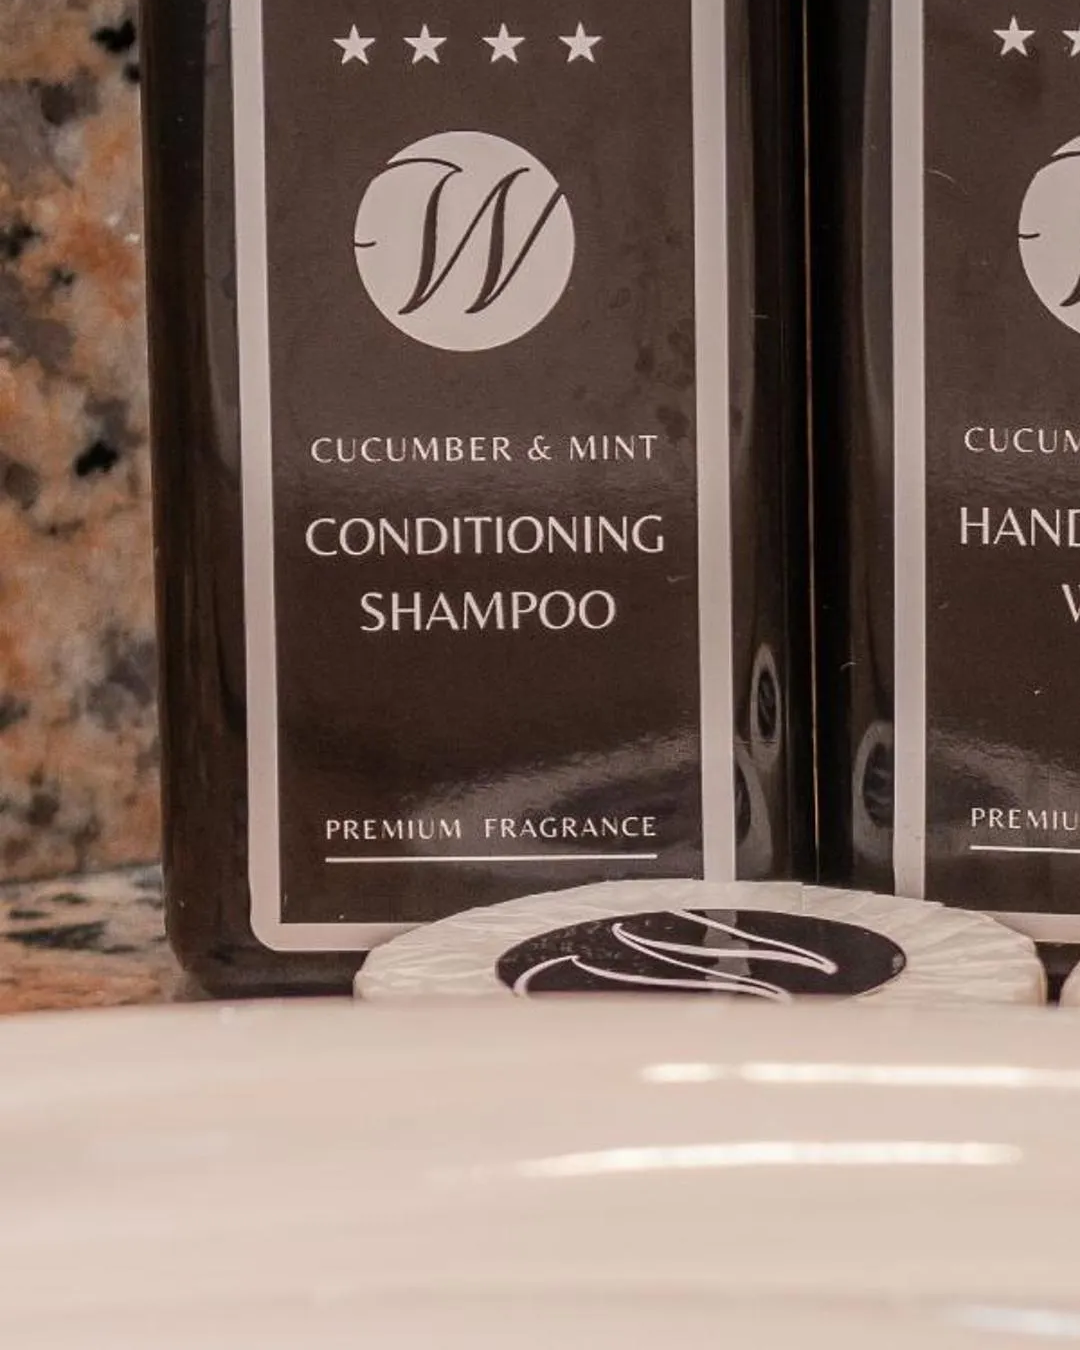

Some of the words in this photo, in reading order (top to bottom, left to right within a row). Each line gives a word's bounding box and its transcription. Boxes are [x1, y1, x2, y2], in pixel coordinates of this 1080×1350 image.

[354, 158, 565, 315] W
[311, 436, 512, 464] CUCUMBER
[527, 435, 552, 461] &
[569, 434, 658, 461] MINT
[305, 514, 664, 556] CONDITIONING
[360, 589, 616, 632] SHAMPOO
[326, 818, 462, 840] PREMIUM
[483, 816, 657, 839] FRAGRANCE
